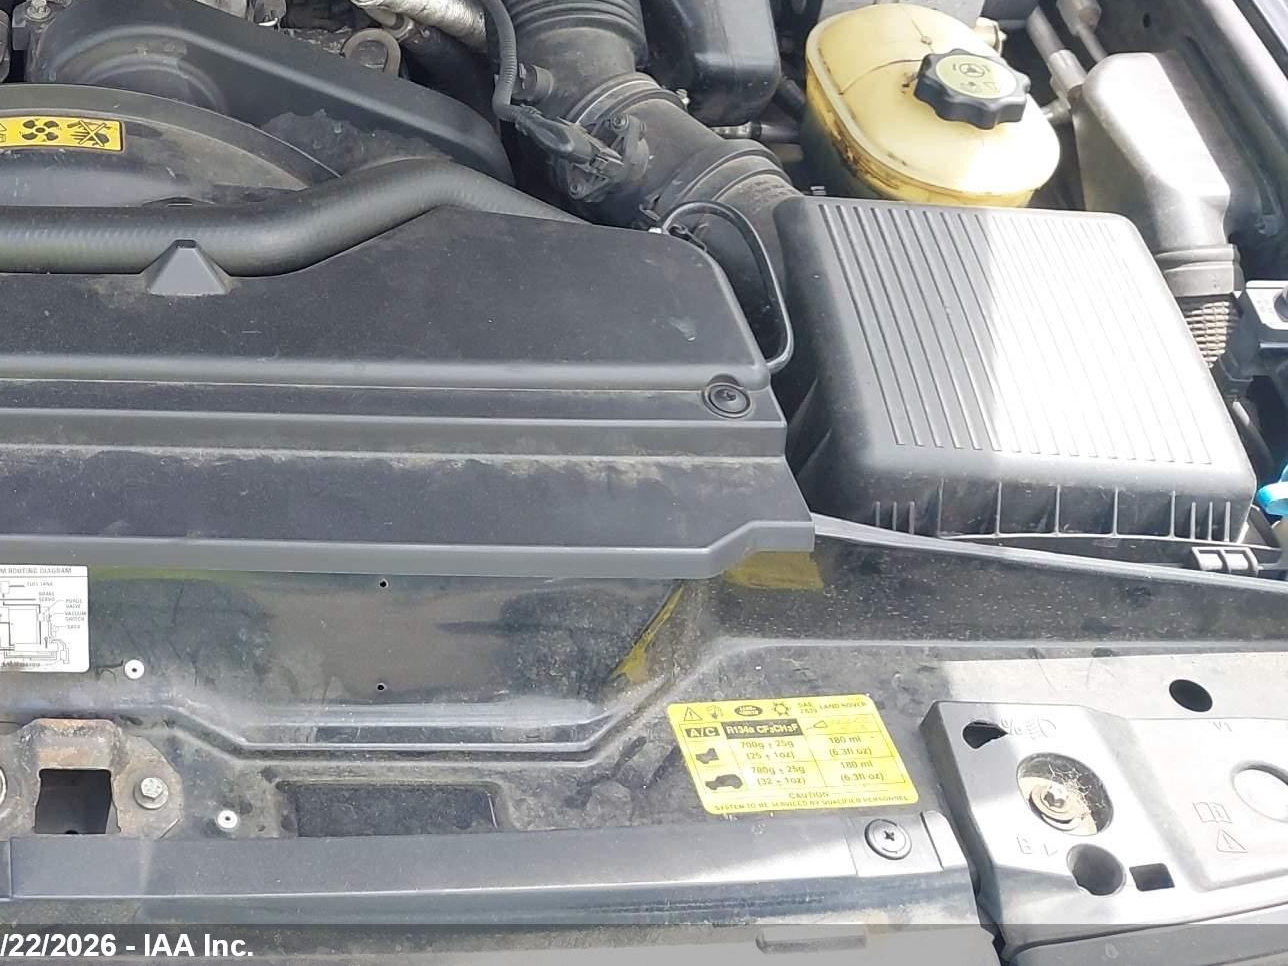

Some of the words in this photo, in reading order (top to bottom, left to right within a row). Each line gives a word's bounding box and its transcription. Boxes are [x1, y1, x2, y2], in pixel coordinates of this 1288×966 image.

[690, 728, 716, 737] A/C
[726, 726, 755, 734] R134a
[775, 740, 794, 748] 25g
[746, 752, 762, 760] (25
[860, 760, 873, 768] ml
